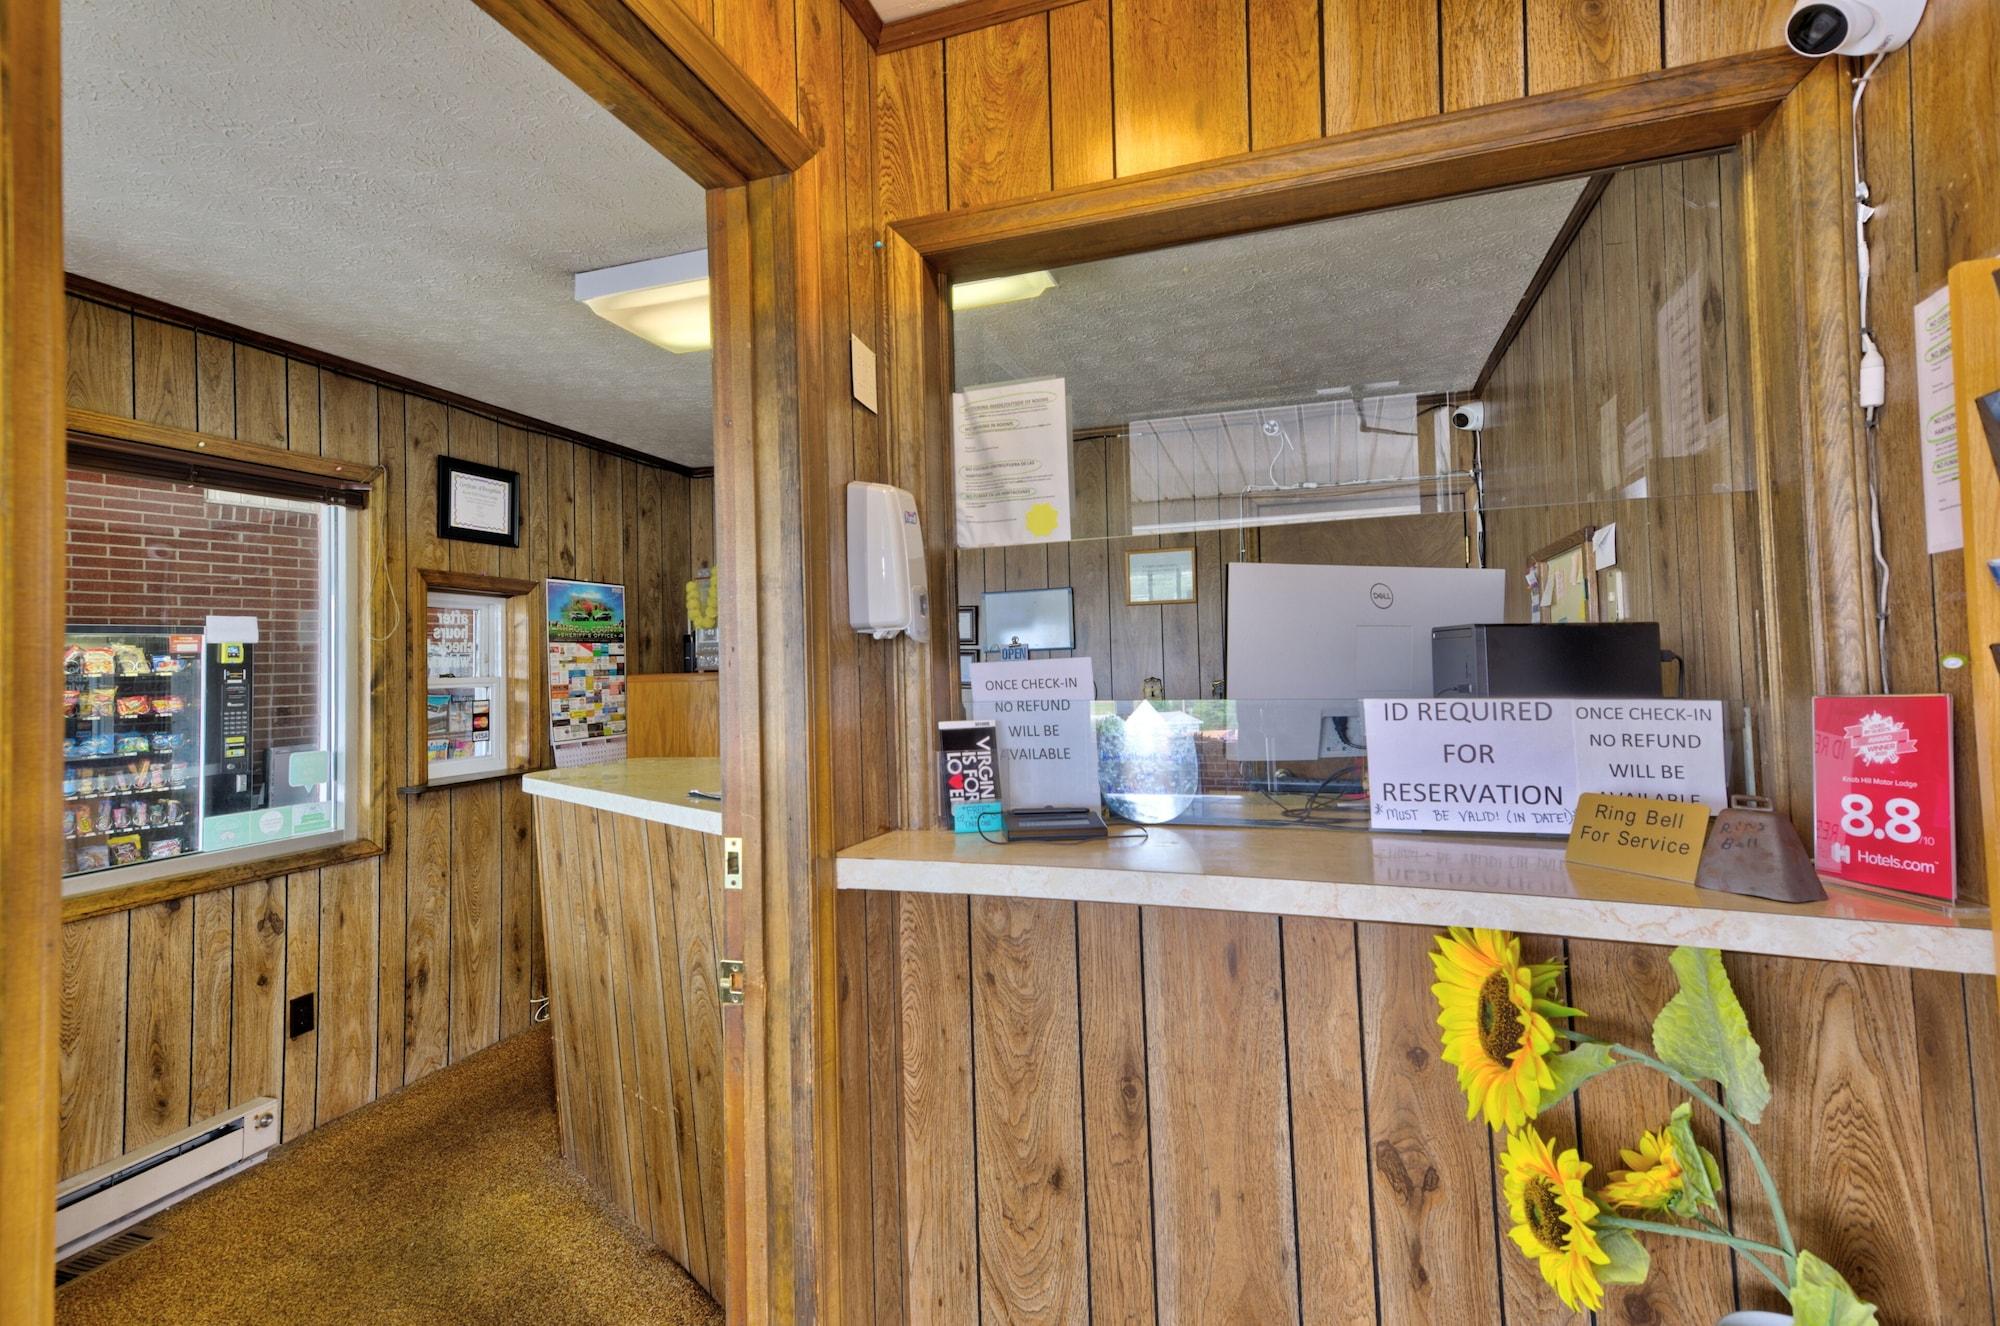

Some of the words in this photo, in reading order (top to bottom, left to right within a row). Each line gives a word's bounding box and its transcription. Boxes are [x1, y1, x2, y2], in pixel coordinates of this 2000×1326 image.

[1002, 648, 1026, 660] OPEN
[985, 680, 1018, 691] ONCE
[1021, 677, 1078, 690] CHECK-IN
[995, 701, 1013, 712] NO
[1017, 699, 1071, 712] REFUND
[1384, 703, 1408, 721] ID
[1418, 702, 1553, 723] REQUIRED
[1576, 706, 1624, 720] ONCE
[1629, 707, 1712, 721] CHECK-IN
[1008, 725, 1040, 737] WILL
[1043, 725, 1060, 737] BE
[1590, 734, 1616, 747] NO
[1622, 733, 1701, 749] REFUND
[1867, 743, 1896, 753] WINNER
[962, 752, 977, 766] IS
[1009, 748, 1071, 760] VAILABLE
[1443, 744, 1495, 764] FOR
[1609, 763, 1655, 779] WILL
[1661, 765, 1685, 780] BE
[963, 769, 980, 801] FOR
[1842, 775, 1860, 785] Knob
[1861, 777, 1872, 785] Hill
[1873, 777, 1893, 787] Motor
[1895, 779, 1918, 789] Lodge
[1383, 782, 1562, 806] RESERVATION
[1433, 809, 1449, 822] BE
[1459, 809, 1500, 823] VALID!
[1506, 809, 1526, 823] (IN
[1595, 803, 1636, 827] Ring
[1646, 809, 1684, 829] Bell
[1840, 794, 1922, 844] 8.8
[1580, 825, 1610, 843] For
[1617, 830, 1690, 855] Service
[1857, 849, 1936, 875] Hotels.com
